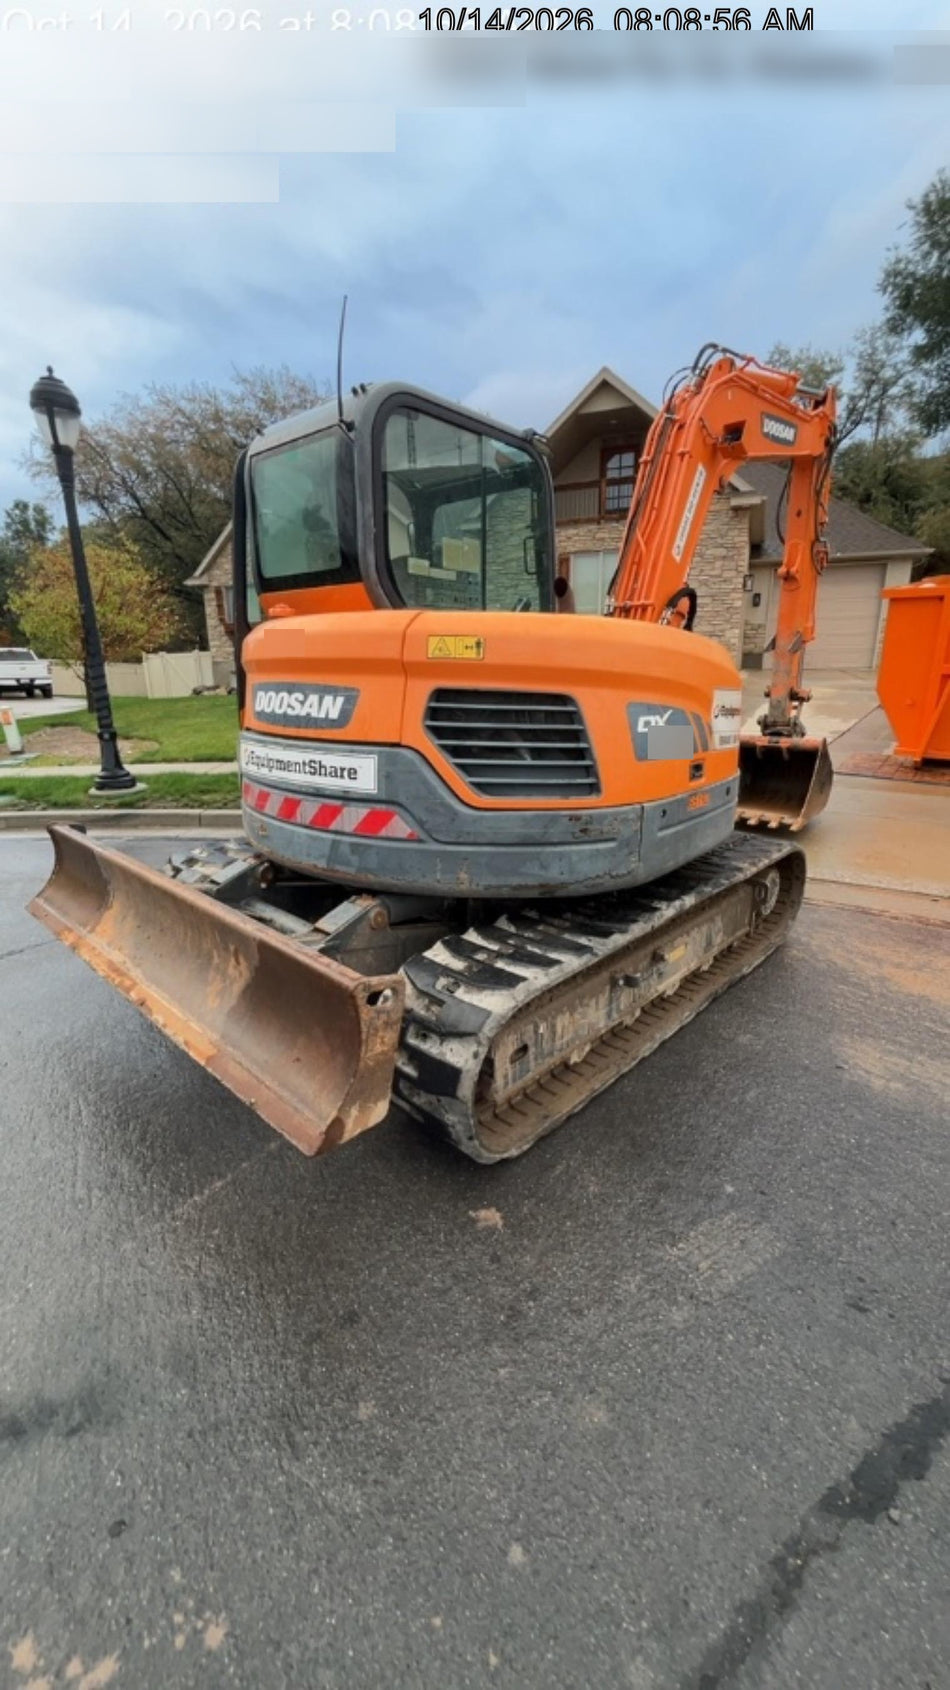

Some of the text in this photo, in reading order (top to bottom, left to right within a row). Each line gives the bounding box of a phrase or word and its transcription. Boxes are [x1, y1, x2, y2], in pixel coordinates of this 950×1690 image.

[763, 417, 796, 443] DOOSAN
[255, 690, 344, 720] DOOSAN
[250, 750, 358, 781] EquipmentShare
